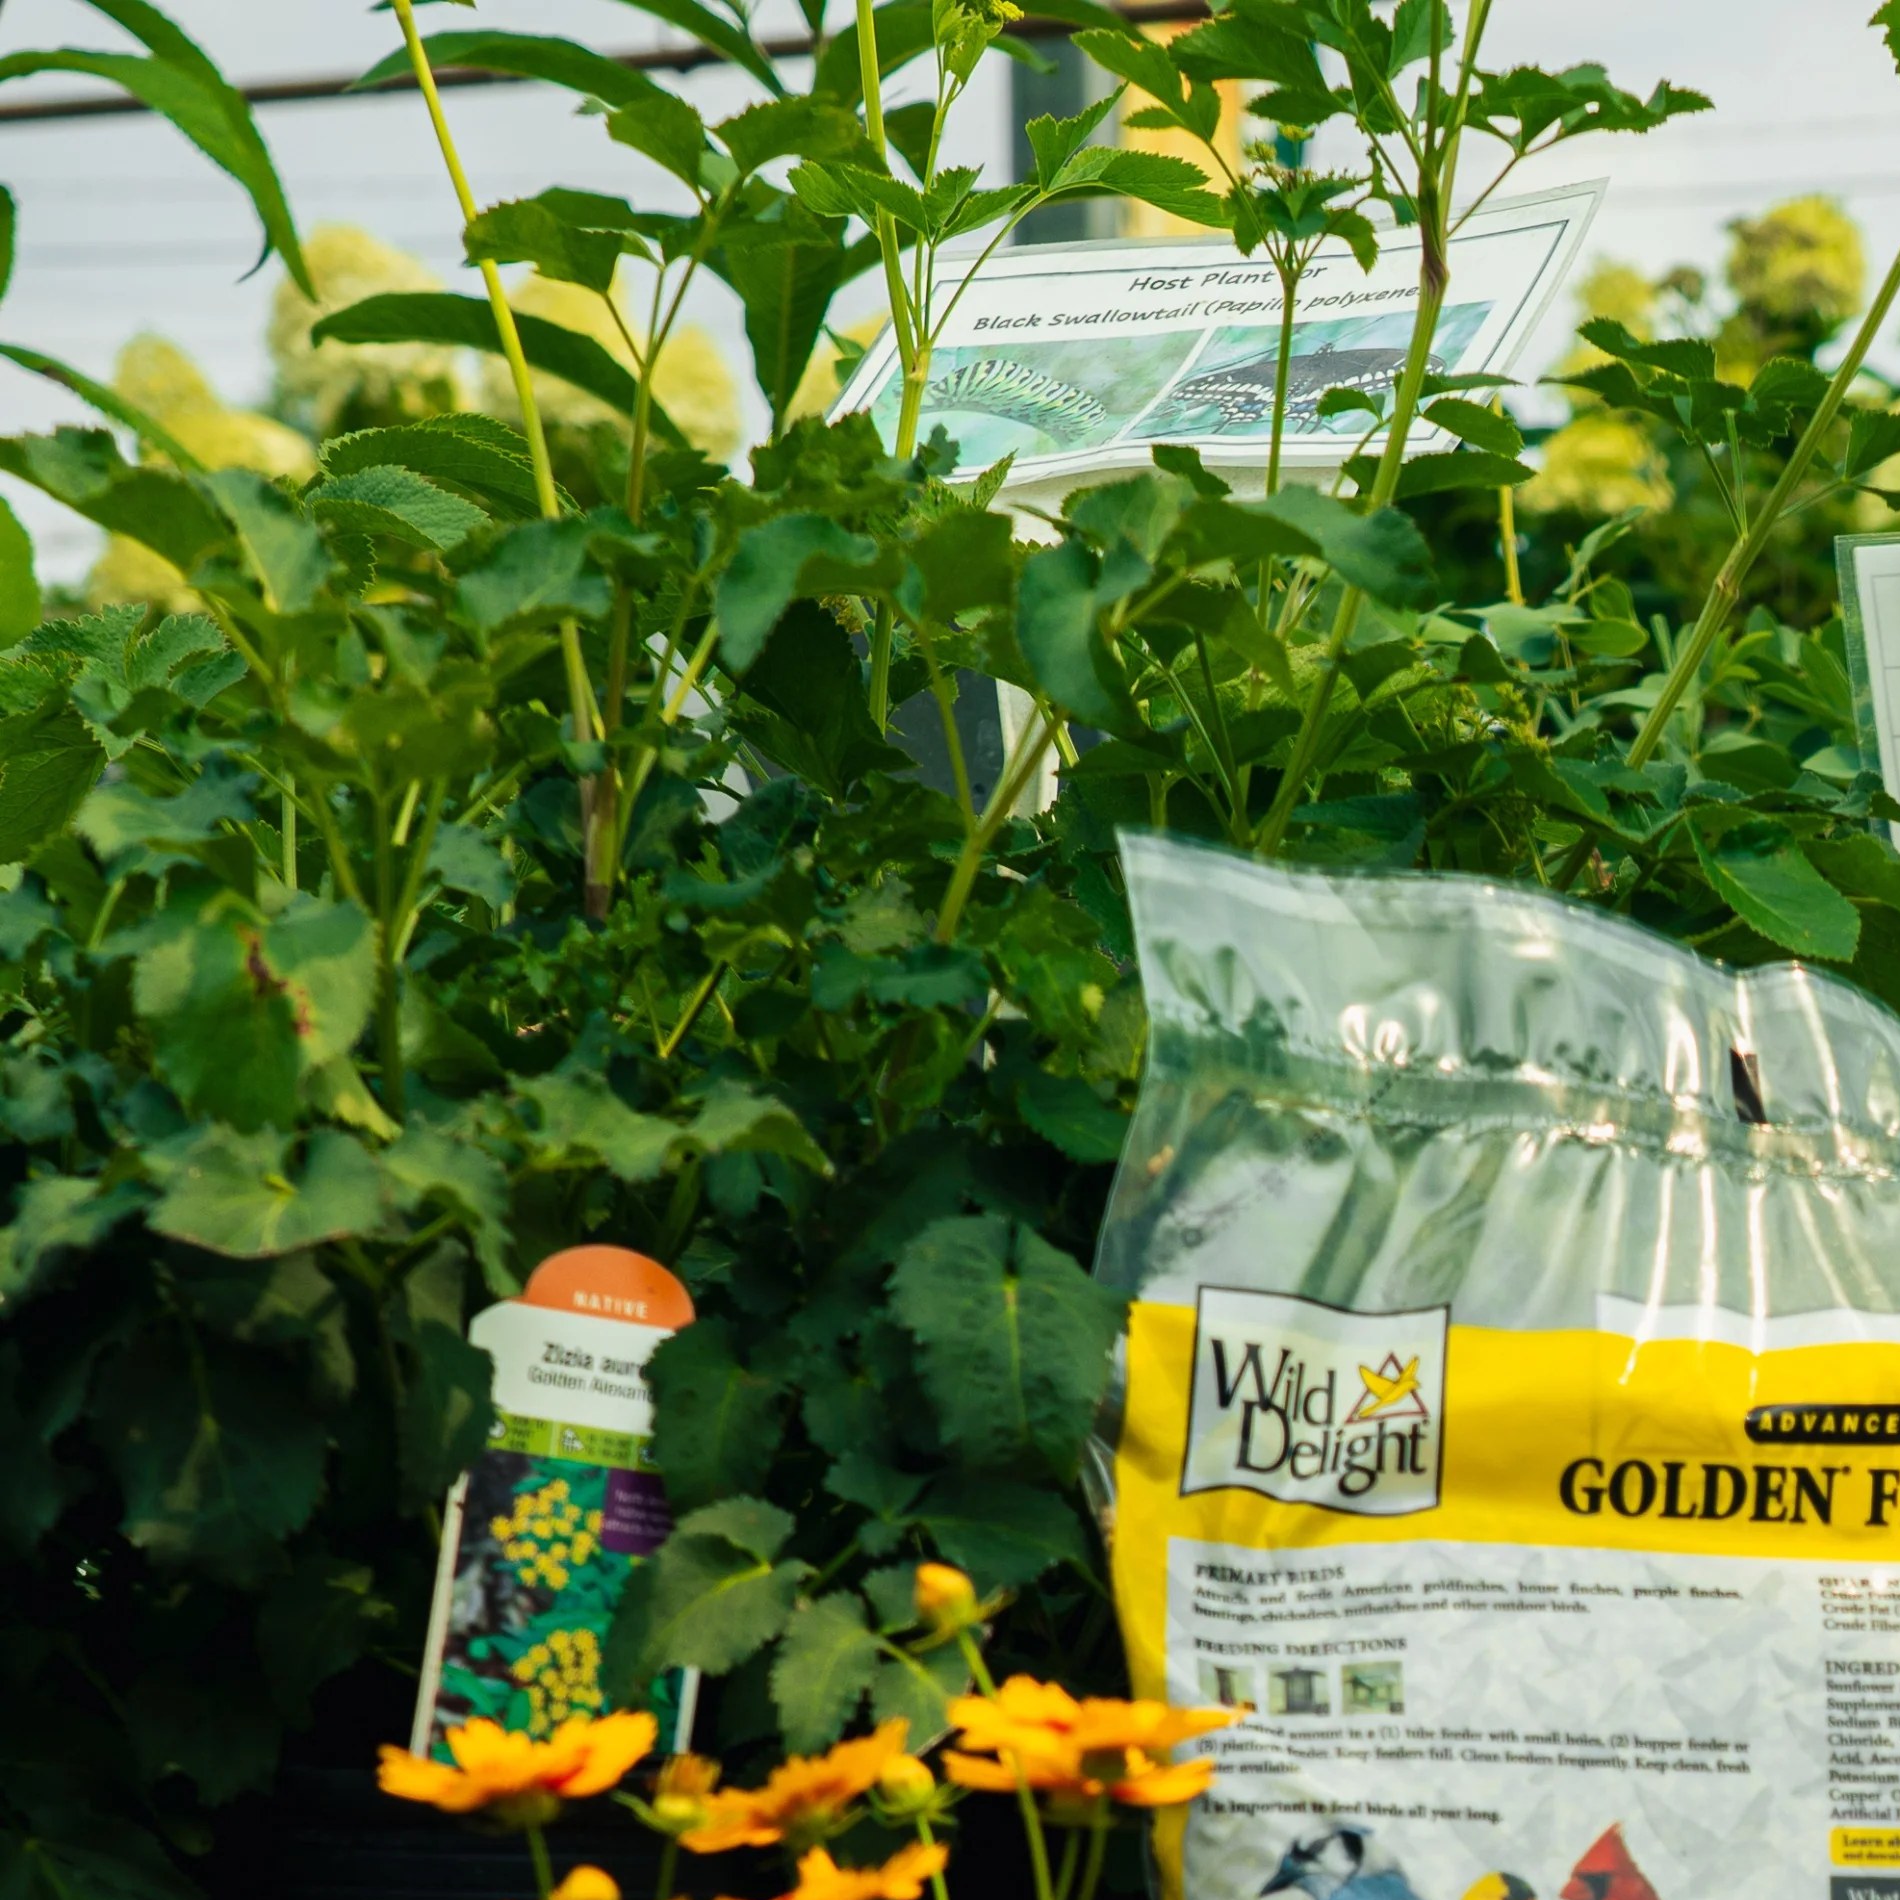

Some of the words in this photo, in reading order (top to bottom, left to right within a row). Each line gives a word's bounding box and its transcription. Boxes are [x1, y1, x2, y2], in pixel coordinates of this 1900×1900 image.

[1129, 276, 1189, 292] Host
[1201, 269, 1273, 287] Plant
[973, 312, 1041, 331] Black
[1049, 302, 1200, 327] Swallowtail
[1304, 285, 1420, 311] polyxene
[574, 1291, 648, 1320] NATIVE
[602, 1357, 640, 1376] aur
[528, 1365, 586, 1391] Golden
[1211, 1339, 1337, 1426] Wild
[1235, 1401, 1428, 1498] Delight
[1559, 1457, 1836, 1524] GOLDEN
[1195, 1565, 1280, 1585] PRIMARY
[1287, 1566, 1345, 1584] BIRDS
[1343, 1584, 1413, 1597] American
[1519, 1581, 1560, 1594] house
[1570, 1582, 1623, 1597] finches,
[1633, 1586, 1680, 1600] purple
[1690, 1586, 1744, 1600] finches,
[1423, 1599, 1448, 1611] and
[1494, 1601, 1548, 1612] outdoor
[1553, 1601, 1591, 1613] birds.
[1285, 1637, 1407, 1655] DIRECTIONS
[1826, 1679, 1894, 1694] Sunflower
[1828, 1716, 1881, 1730] Sodium
[1406, 1728, 1435, 1740] tube
[1441, 1727, 1483, 1741] feeder
[1489, 1731, 1518, 1742] with
[1524, 1731, 1561, 1745] small
[1566, 1733, 1605, 1748] holes,
[1634, 1736, 1682, 1752] hopper
[1688, 1739, 1729, 1752] feeder
[1827, 1734, 1895, 1748] Chloride,
[1506, 1752, 1552, 1766] feeders
[1635, 1756, 1669, 1774] Keep
[1716, 1760, 1750, 1774] fresh
[1829, 1752, 1864, 1766] Acid,
[1829, 1770, 1899, 1784] Potassium
[1829, 1790, 1881, 1805] Copper
[1367, 1801, 1403, 1816] birds
[1830, 1808, 1891, 1821] Artificial
[1843, 1835, 1884, 1848] Learn
